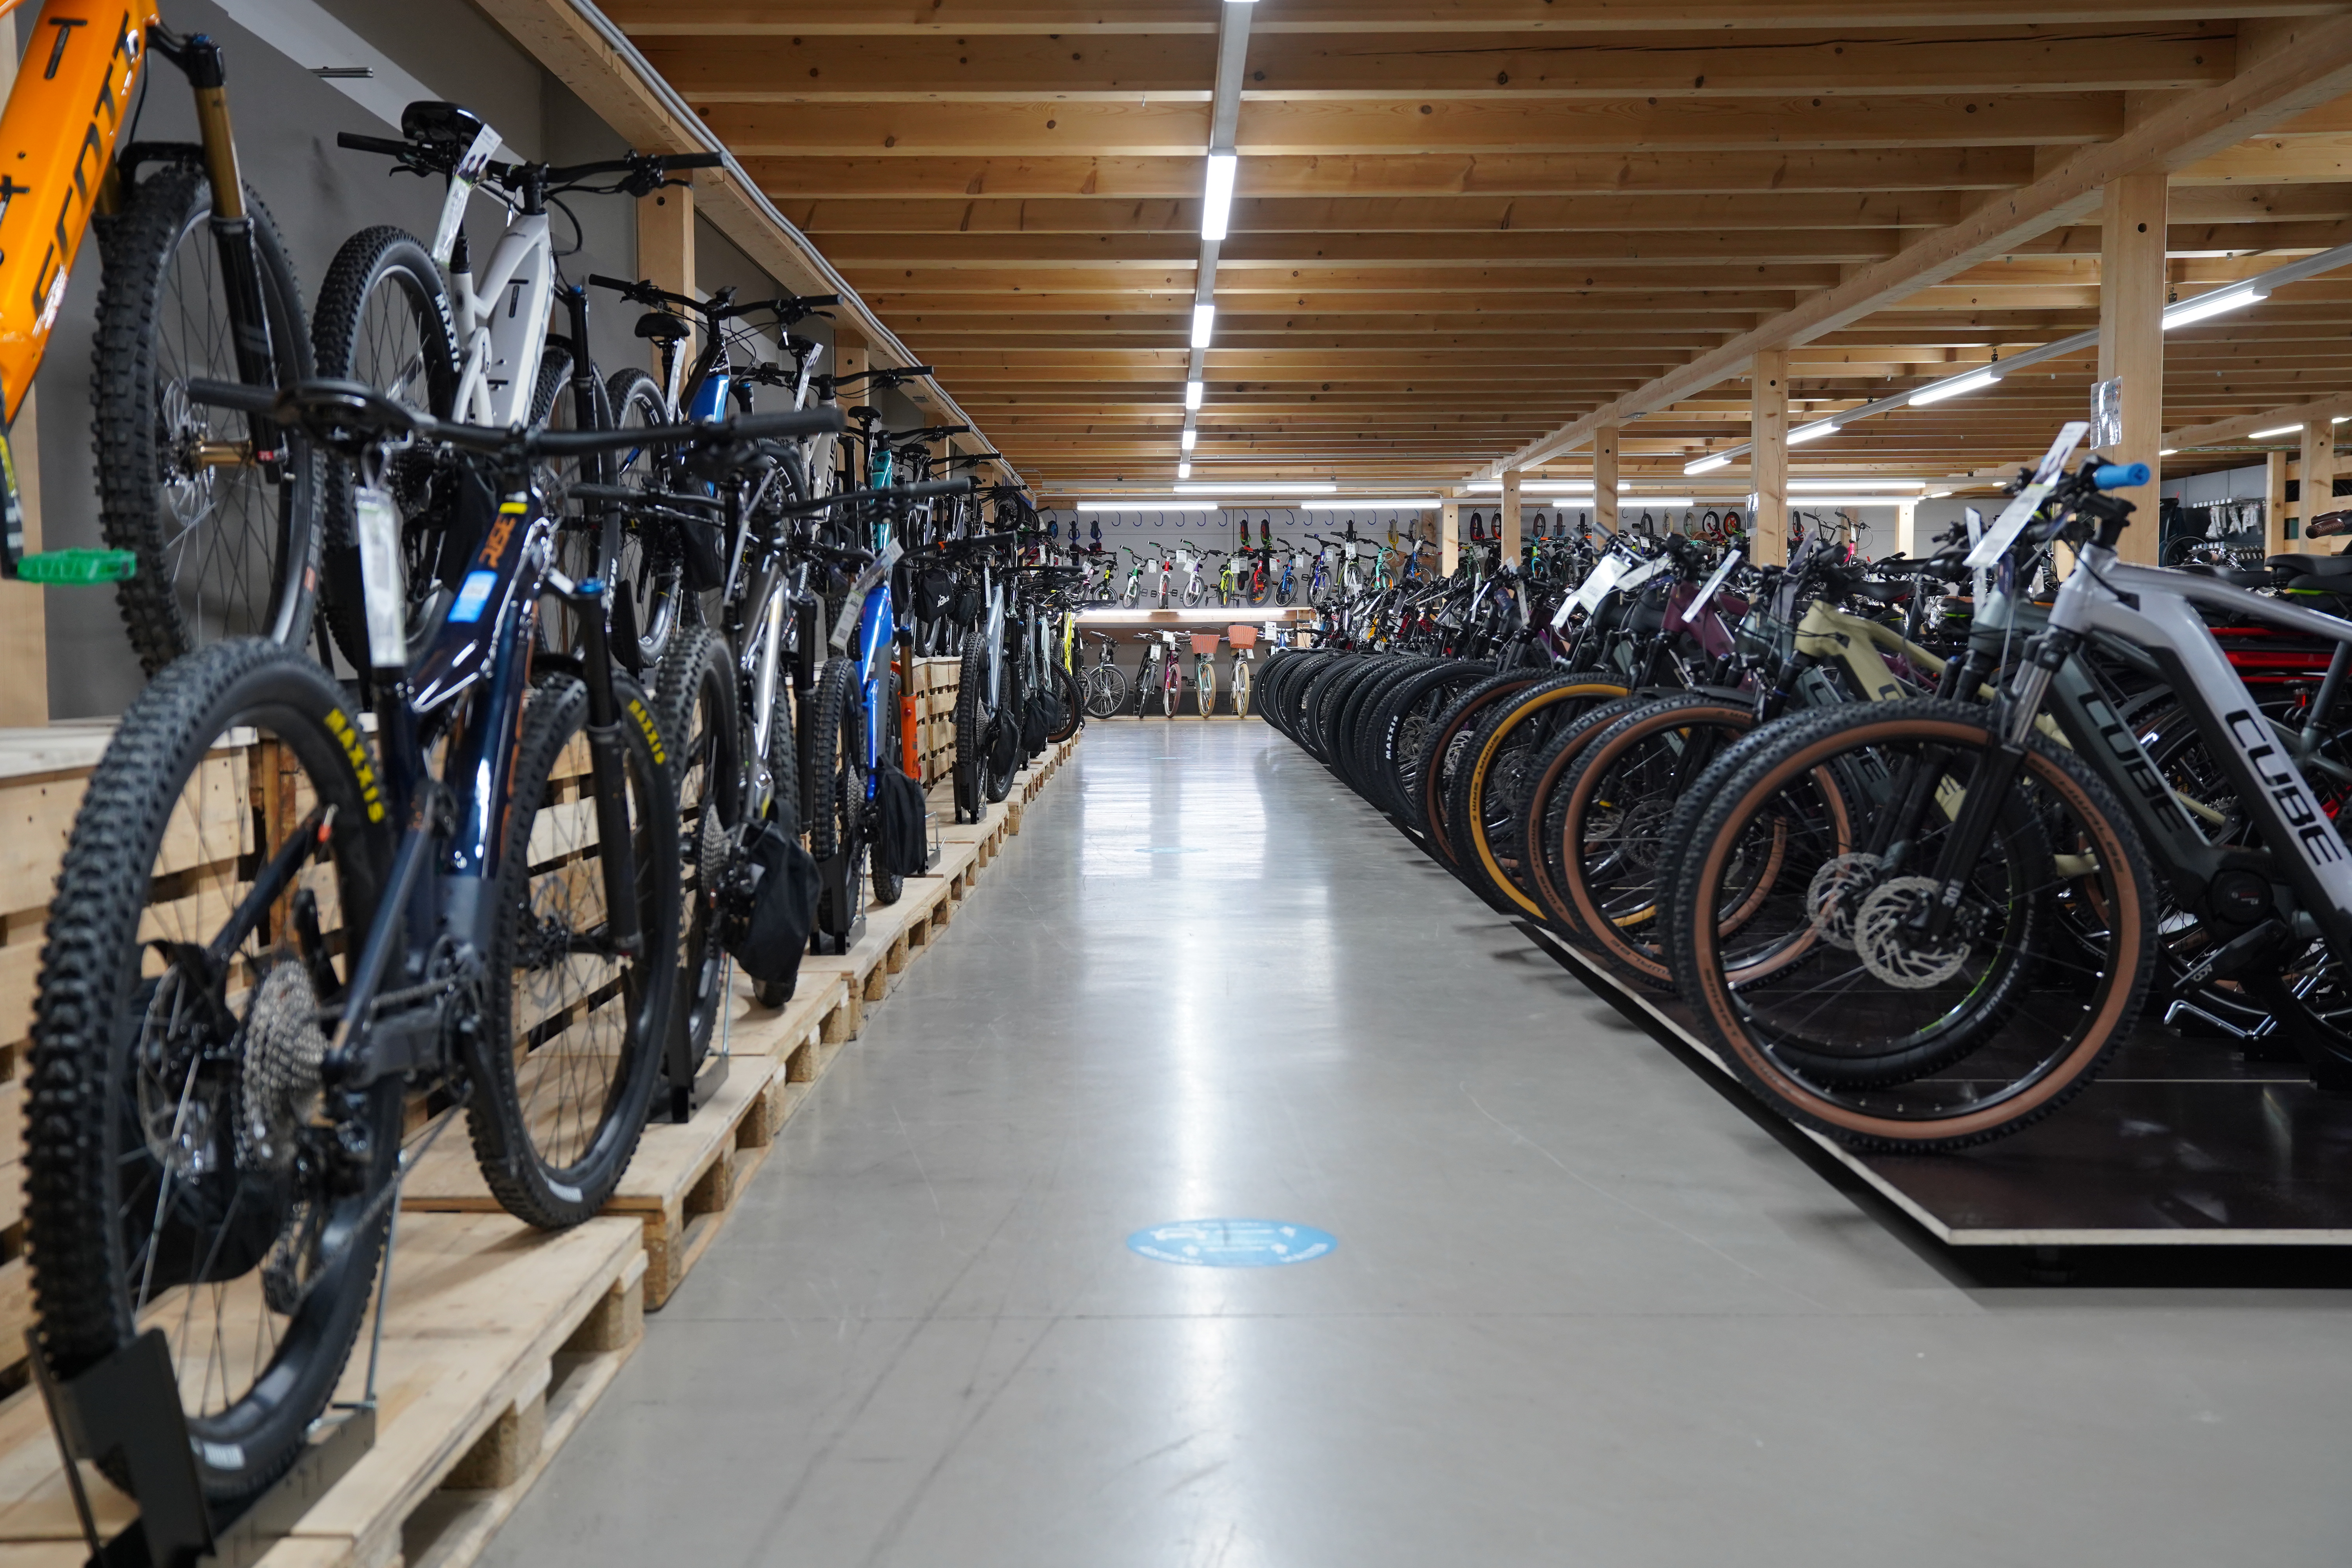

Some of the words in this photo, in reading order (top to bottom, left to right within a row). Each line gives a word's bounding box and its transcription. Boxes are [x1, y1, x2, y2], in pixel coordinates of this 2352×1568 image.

[435, 293, 461, 372] MAXXIS
[799, 562, 808, 590] MINION
[323, 708, 385, 824] MAXXIS
[628, 699, 665, 766] MAXXIS
[1386, 715, 1398, 760] MAXXIS
[1476, 734, 1499, 778] SMART
[2078, 691, 2183, 834] CUBE
[2027, 756, 2123, 873] SCHWALBE
[2225, 709, 2342, 866] CUBE
[1532, 819, 1541, 870] SMART
[1539, 875, 1557, 904] SAM
[1705, 968, 1739, 1037] SMART
